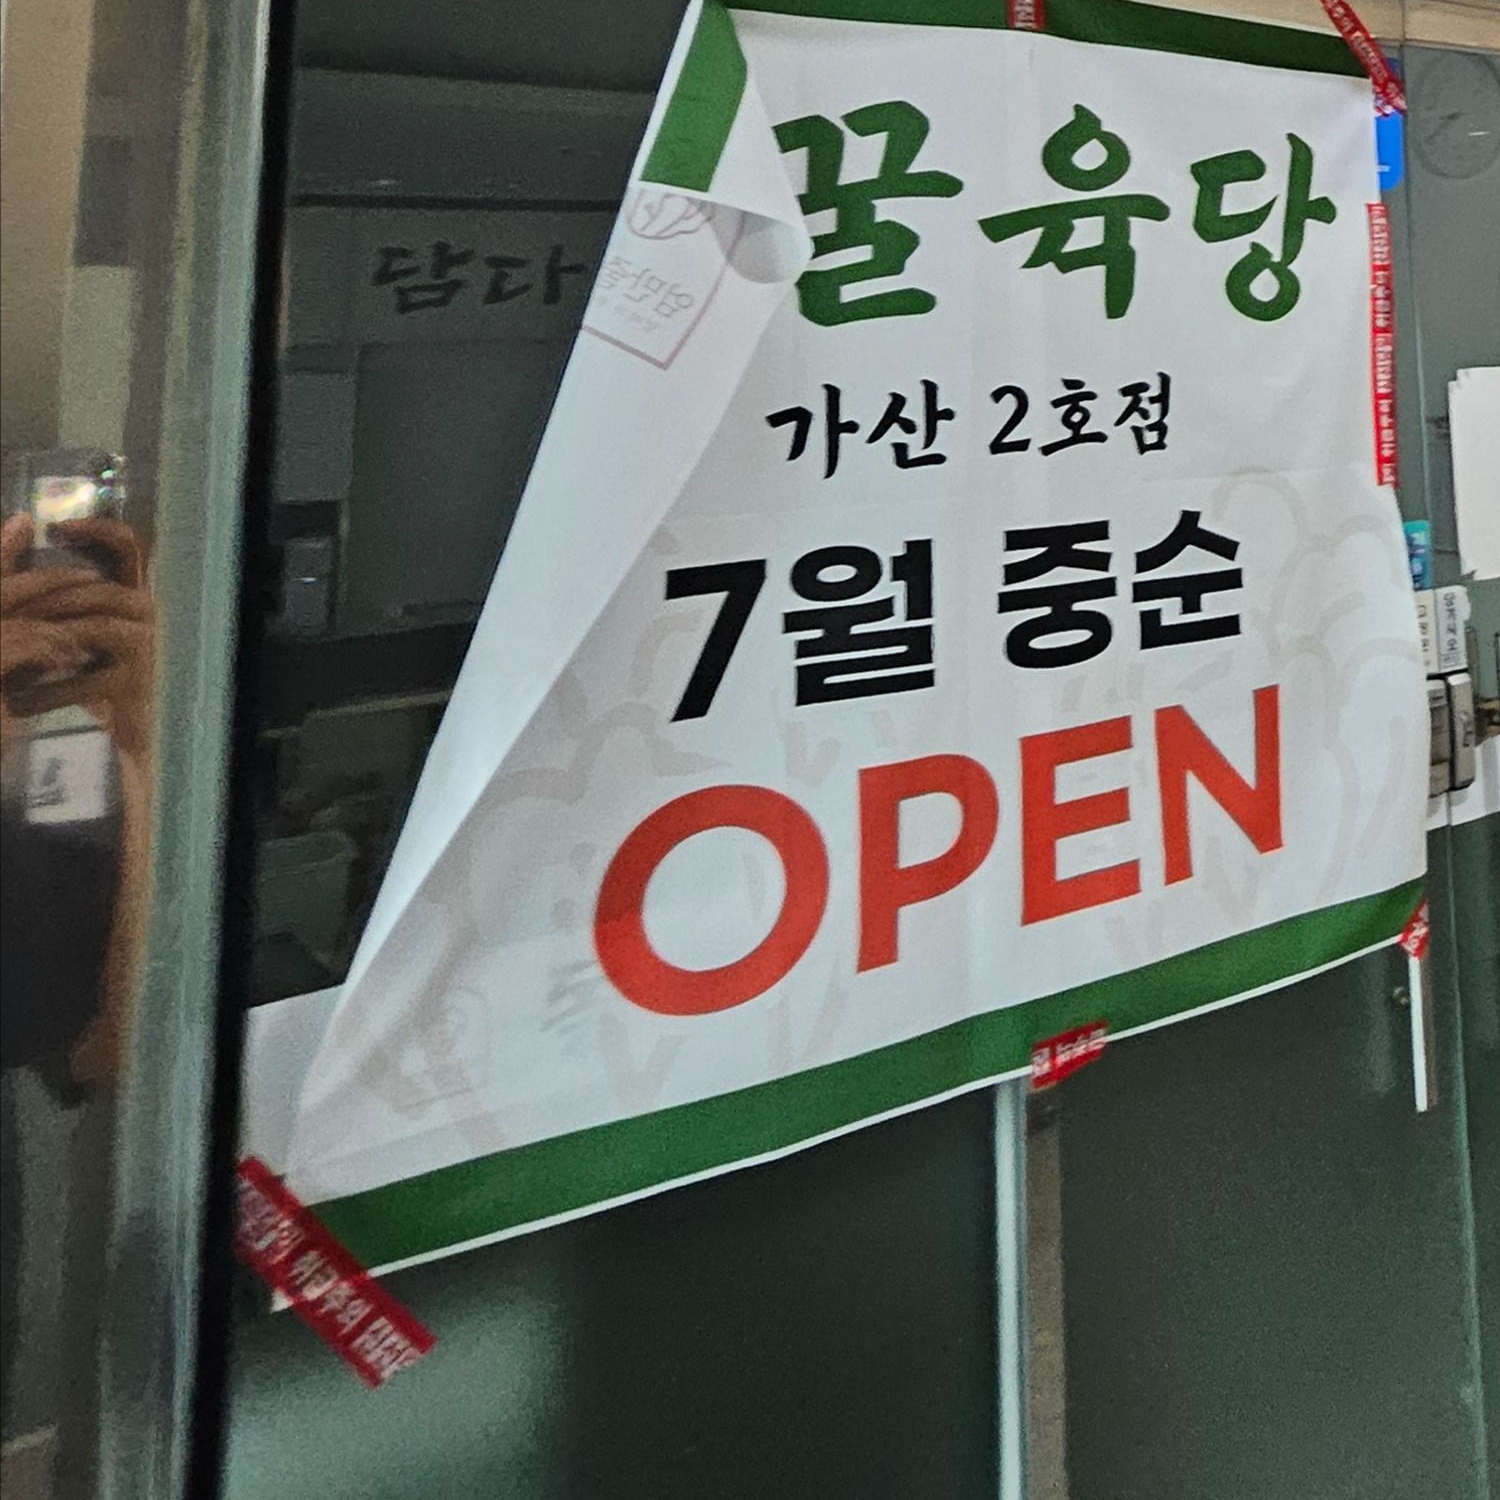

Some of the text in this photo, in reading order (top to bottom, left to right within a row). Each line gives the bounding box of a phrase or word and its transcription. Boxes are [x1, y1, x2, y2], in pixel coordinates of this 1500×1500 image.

[773, 100, 1337, 328] 꿀육당
[765, 371, 1173, 480] 가산 2호점
[664, 537, 936, 724] 7월
[996, 508, 1244, 670] 중순
[593, 684, 1284, 1017] OPEN
